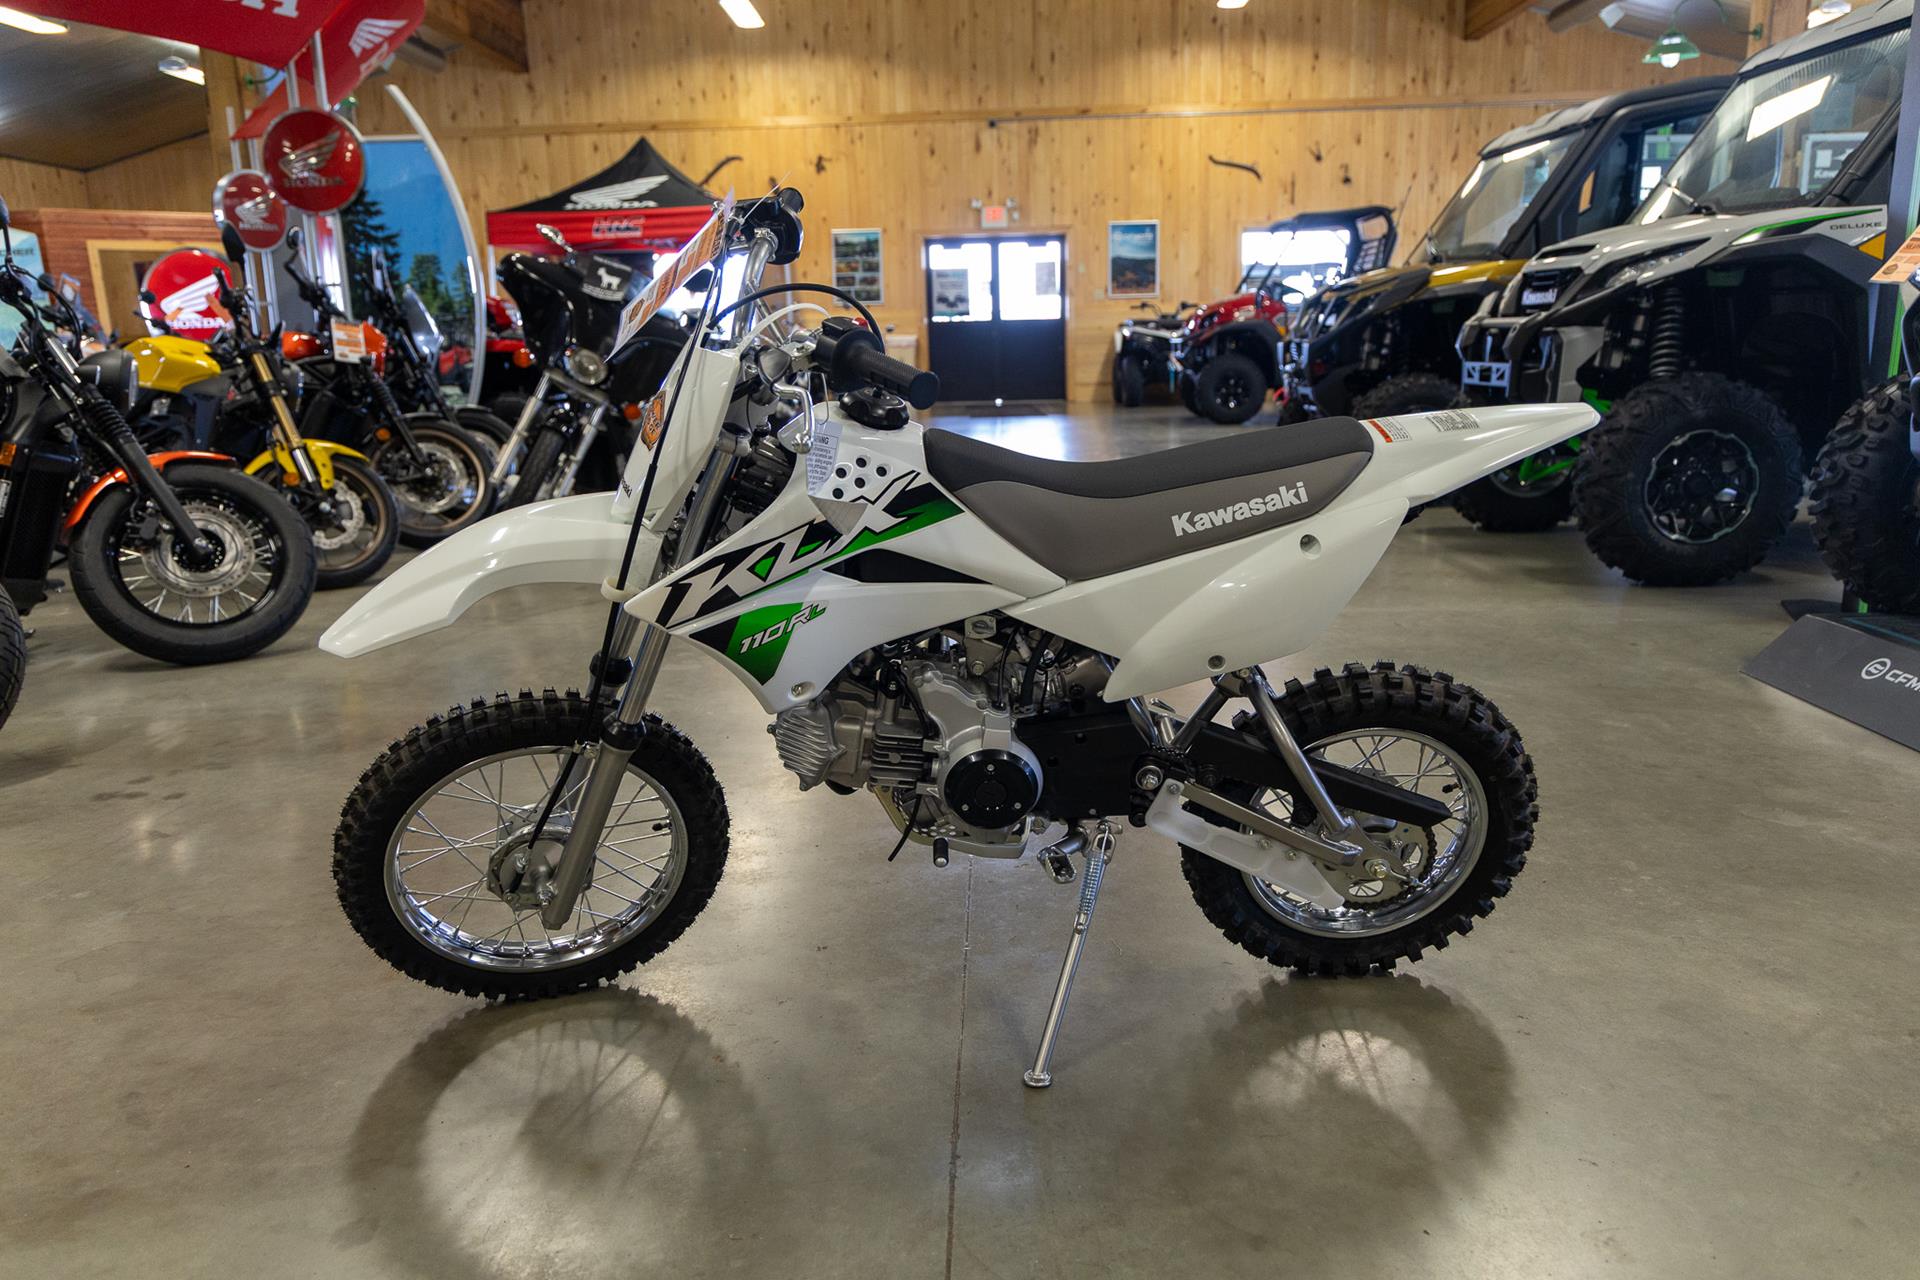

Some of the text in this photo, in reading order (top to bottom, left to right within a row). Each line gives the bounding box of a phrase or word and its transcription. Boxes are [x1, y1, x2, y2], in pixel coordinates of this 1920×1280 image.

[1829, 221, 1883, 231] DELUXE
[1171, 481, 1309, 537] Kawasaki
[1885, 669, 1920, 692] CFM
